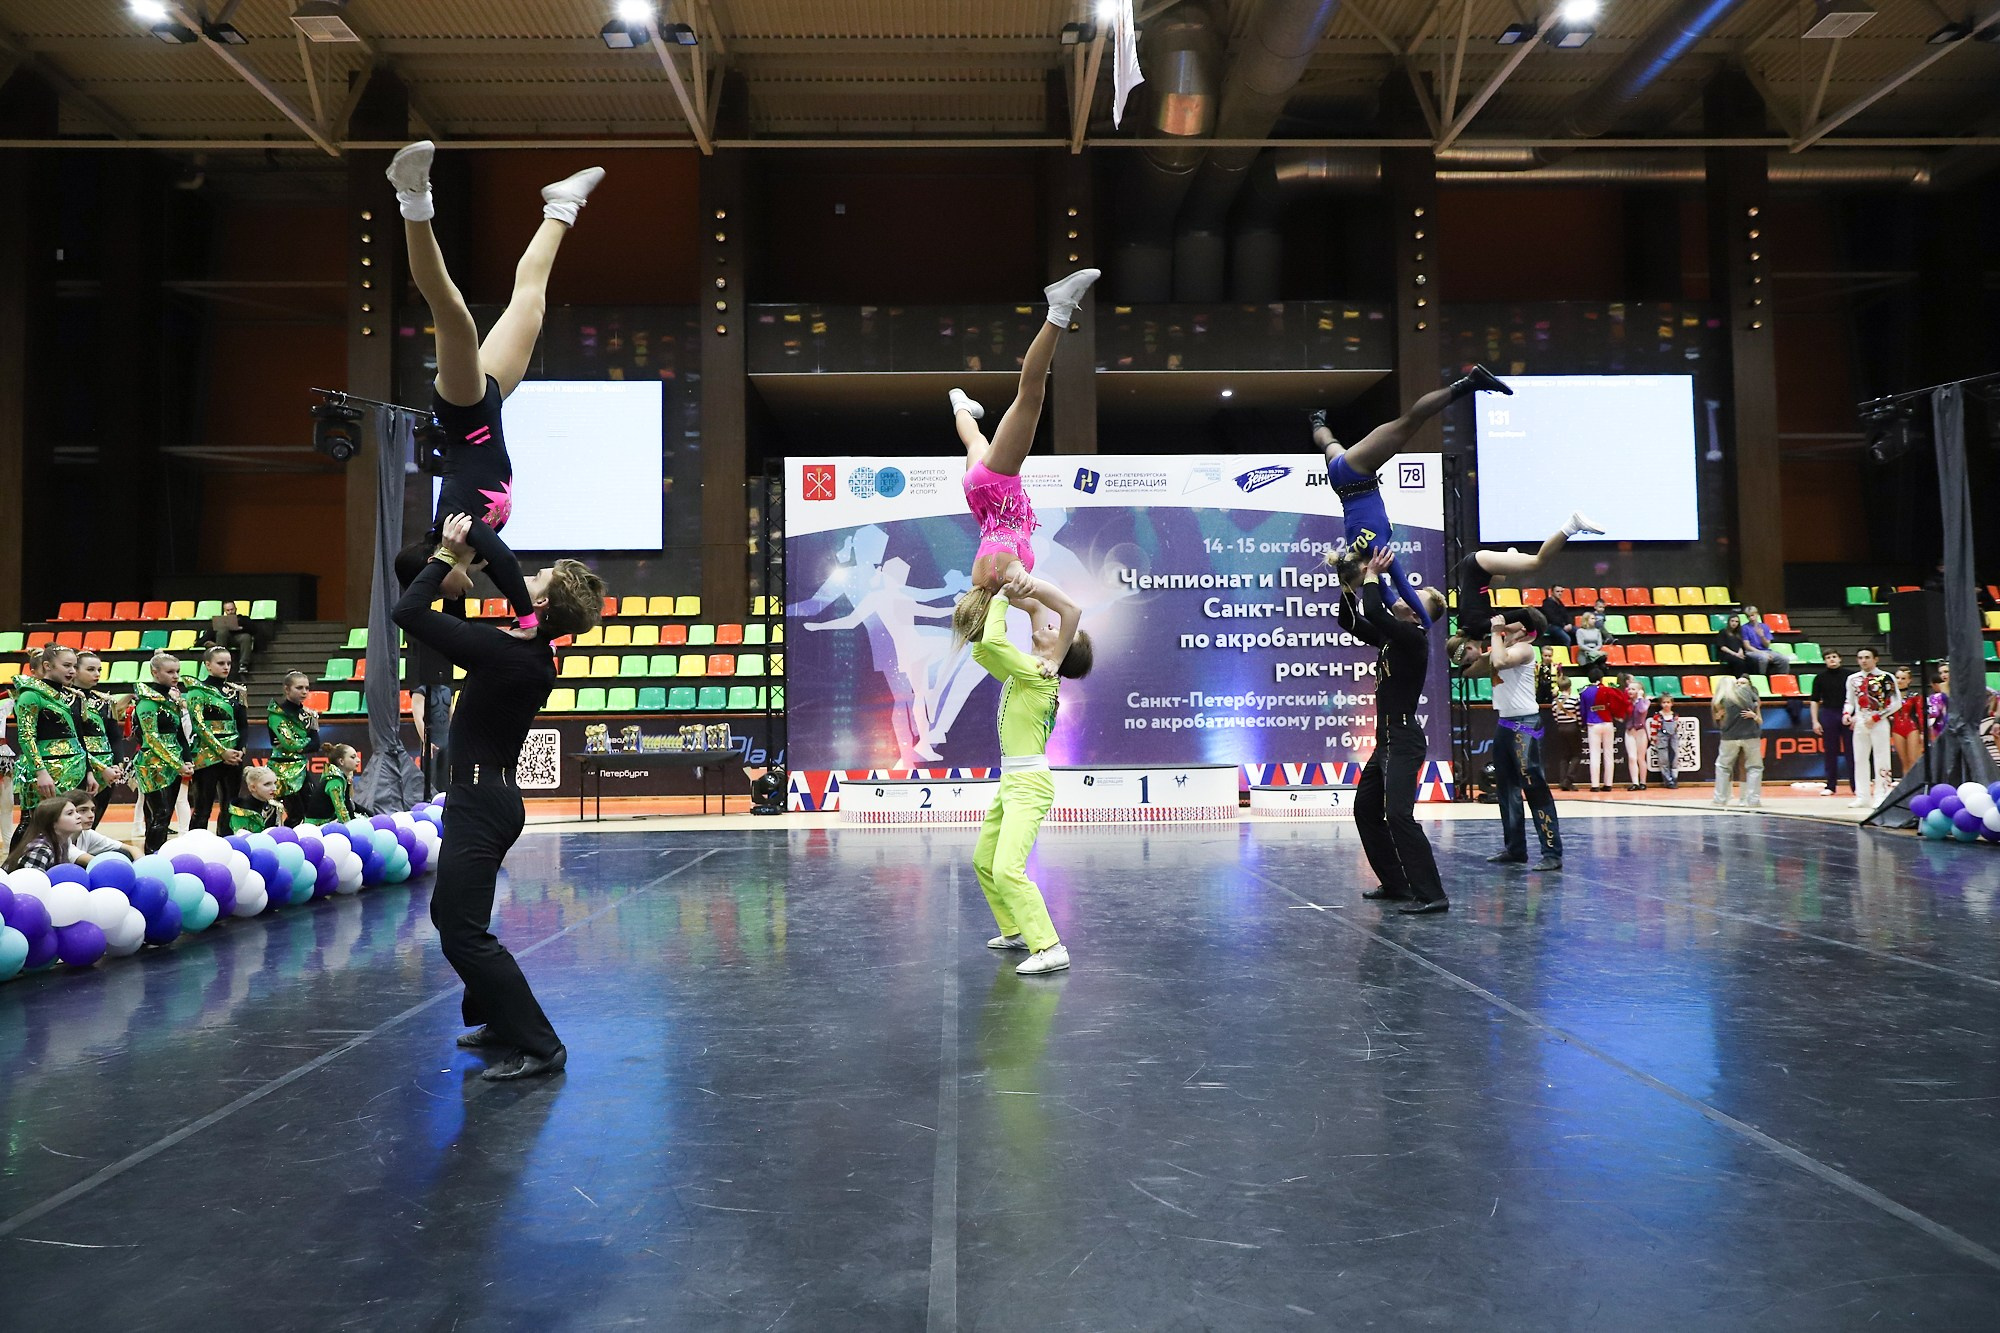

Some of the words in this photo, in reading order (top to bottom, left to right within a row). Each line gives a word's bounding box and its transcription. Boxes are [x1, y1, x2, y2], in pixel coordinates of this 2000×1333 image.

[1488, 410, 1510, 426] 131
[1104, 479, 1167, 488] ФЕДЕРАЦИЯ
[1403, 468, 1421, 484] 78
[1204, 538, 1224, 554] 14
[1237, 538, 1256, 554] 15
[1259, 538, 1332, 556] октября
[1387, 541, 1423, 554] ода
[1120, 568, 1254, 589] Чемпионат
[1259, 574, 1274, 588] и
[1180, 633, 1210, 649] по
[1127, 691, 1329, 710] Санкт-Петербургский
[1124, 717, 1147, 730] по
[1150, 713, 1311, 732] акробатическому
[1326, 736, 1337, 747] и
[600, 769, 649, 778] Петербурга
[1138, 775, 1151, 804] 1
[919, 787, 933, 809] 2
[1330, 792, 1340, 807] 3
